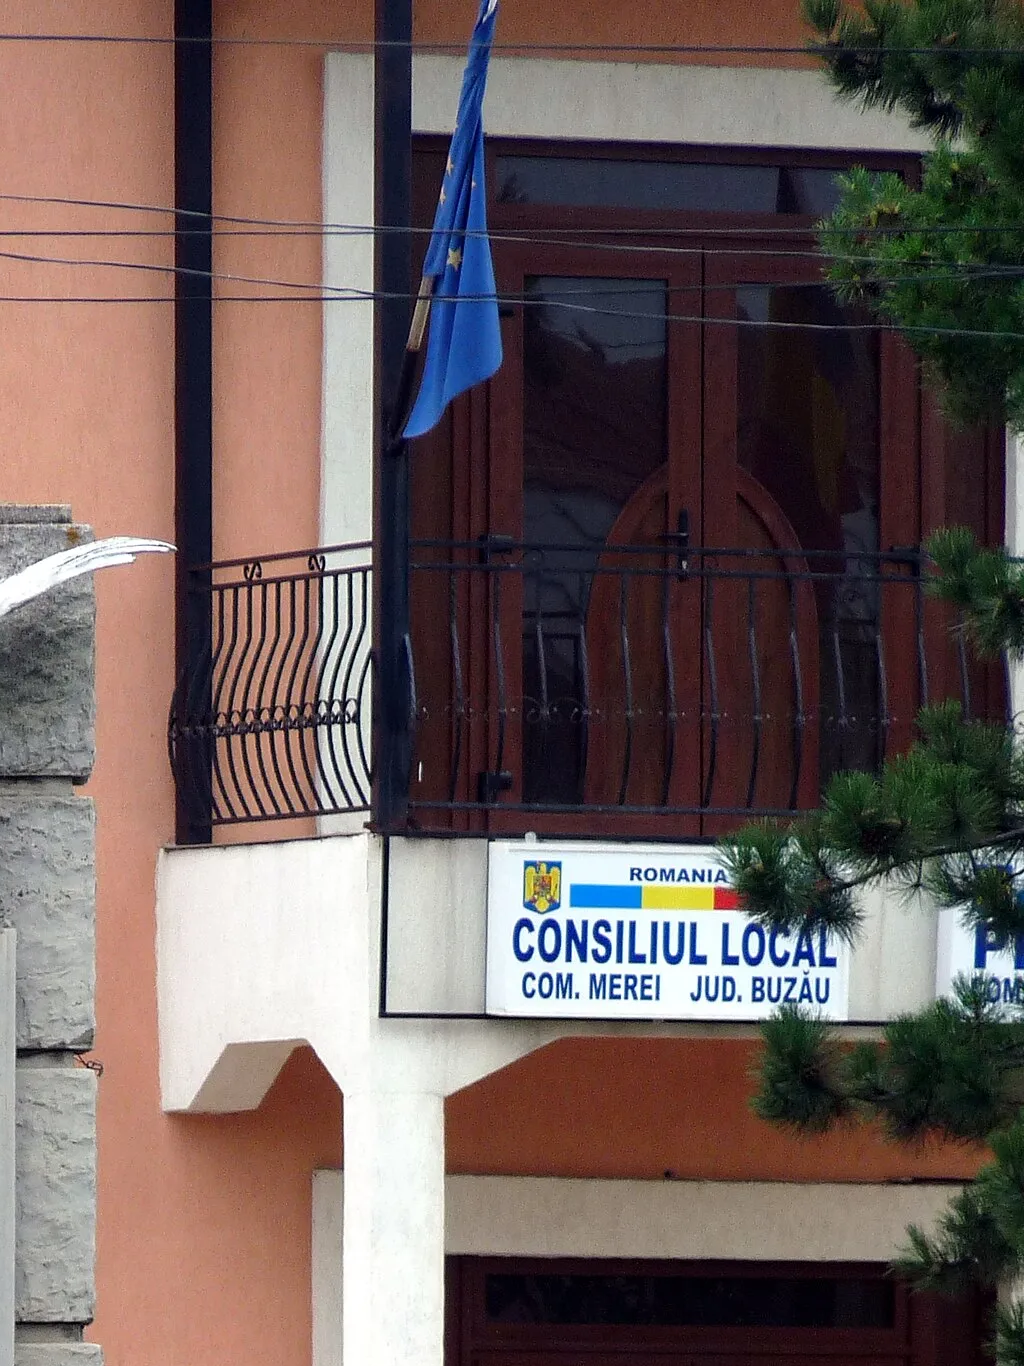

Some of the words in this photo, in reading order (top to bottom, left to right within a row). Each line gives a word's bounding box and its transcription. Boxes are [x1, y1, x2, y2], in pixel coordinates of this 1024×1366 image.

[629, 867, 728, 882] ROMANIA
[513, 917, 708, 966] CONSILIUL
[721, 921, 837, 968] LOCAL
[522, 971, 580, 1000] COM.
[589, 973, 660, 1001] MEREI
[690, 975, 742, 1002] JUD.
[751, 970, 831, 1004] BUZĂU
